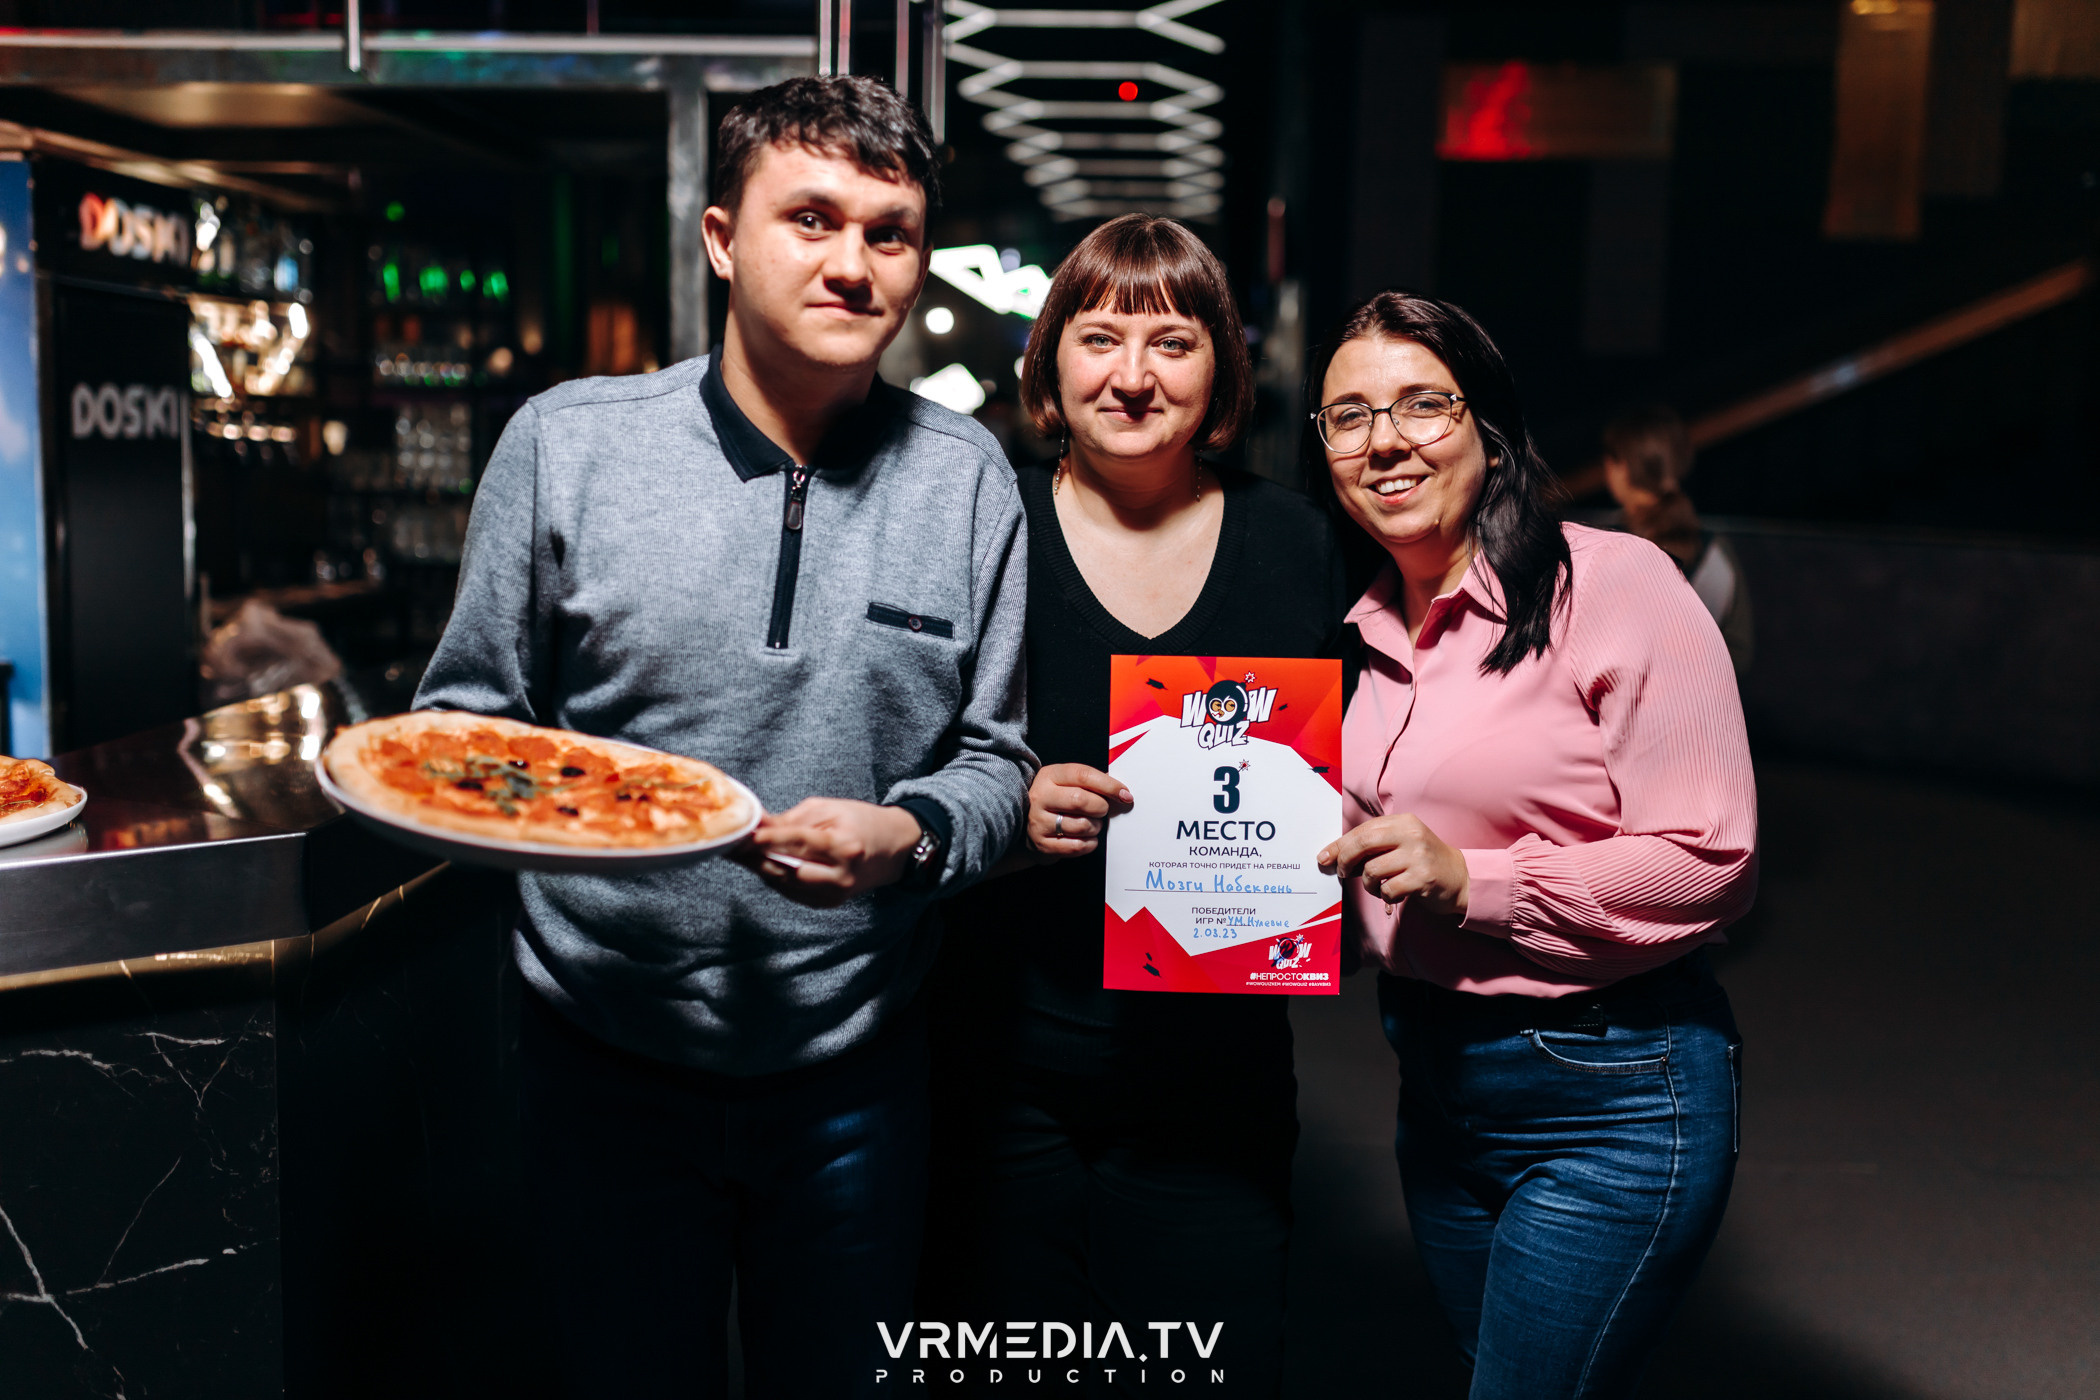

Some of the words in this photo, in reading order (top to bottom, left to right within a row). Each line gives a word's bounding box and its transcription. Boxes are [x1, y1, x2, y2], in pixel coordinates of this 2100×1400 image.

[79, 192, 190, 266] DOSKI
[72, 384, 179, 438] DOSKI
[1198, 719, 1250, 750] QUIZ
[1213, 765, 1241, 814] 3
[1176, 820, 1277, 841] МЕСТО
[1189, 846, 1262, 858] КОМАНДА,
[1149, 861, 1188, 869] КОТОРАЯ
[1189, 862, 1218, 870] ТОЧНО
[1219, 862, 1252, 871] ПРИДЕТ
[1146, 869, 1204, 892] Мозги
[1214, 874, 1292, 894] Набекрень
[1191, 907, 1256, 916] ПОБЕДИТЕЛИ
[1195, 917, 1214, 925] ИГР
[1193, 927, 1238, 939] 2.03.23
[1276, 957, 1300, 970] QUIZ
[1250, 972, 1329, 981] #НЕПРОСТОКВИЗ
